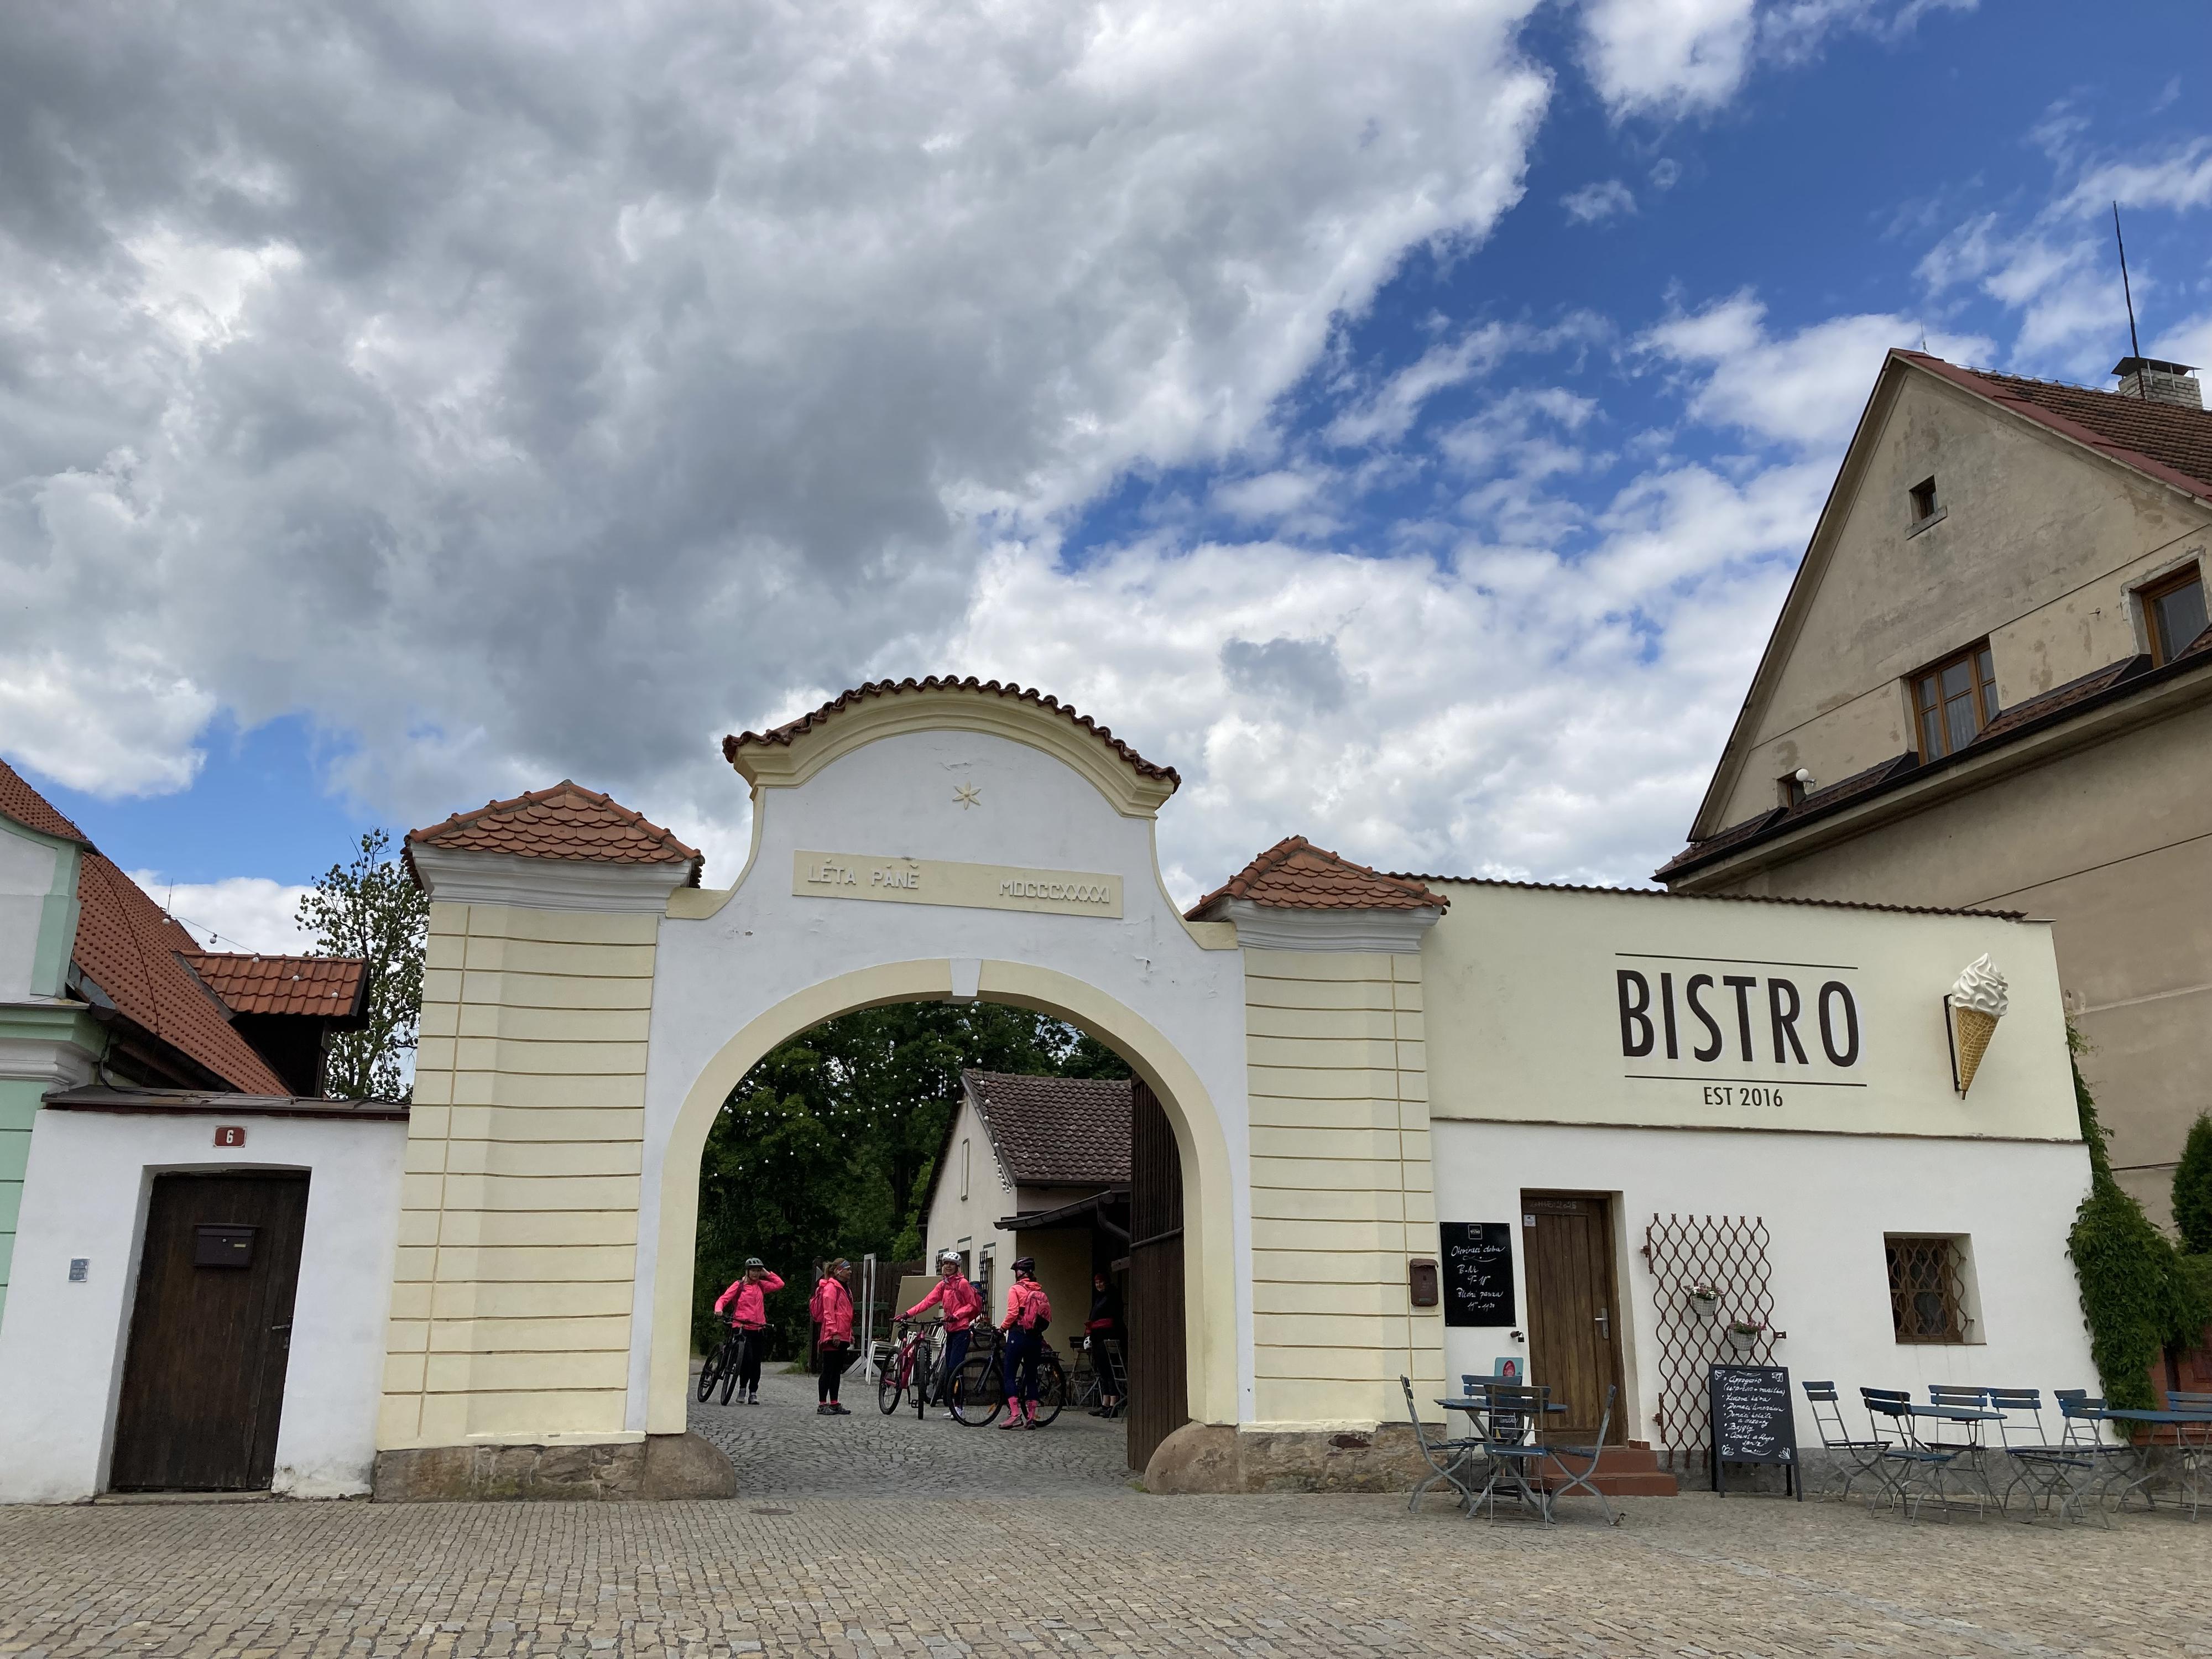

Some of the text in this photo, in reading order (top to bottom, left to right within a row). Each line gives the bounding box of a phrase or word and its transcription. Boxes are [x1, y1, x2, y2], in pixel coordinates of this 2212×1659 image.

[808, 858, 856, 885] LÉTA
[871, 863, 920, 889] PÁNĚ
[1616, 969, 1859, 1067] BISTRO
[1704, 1087, 1783, 1107] EST 2016
[226, 1129, 234, 1144] 6
